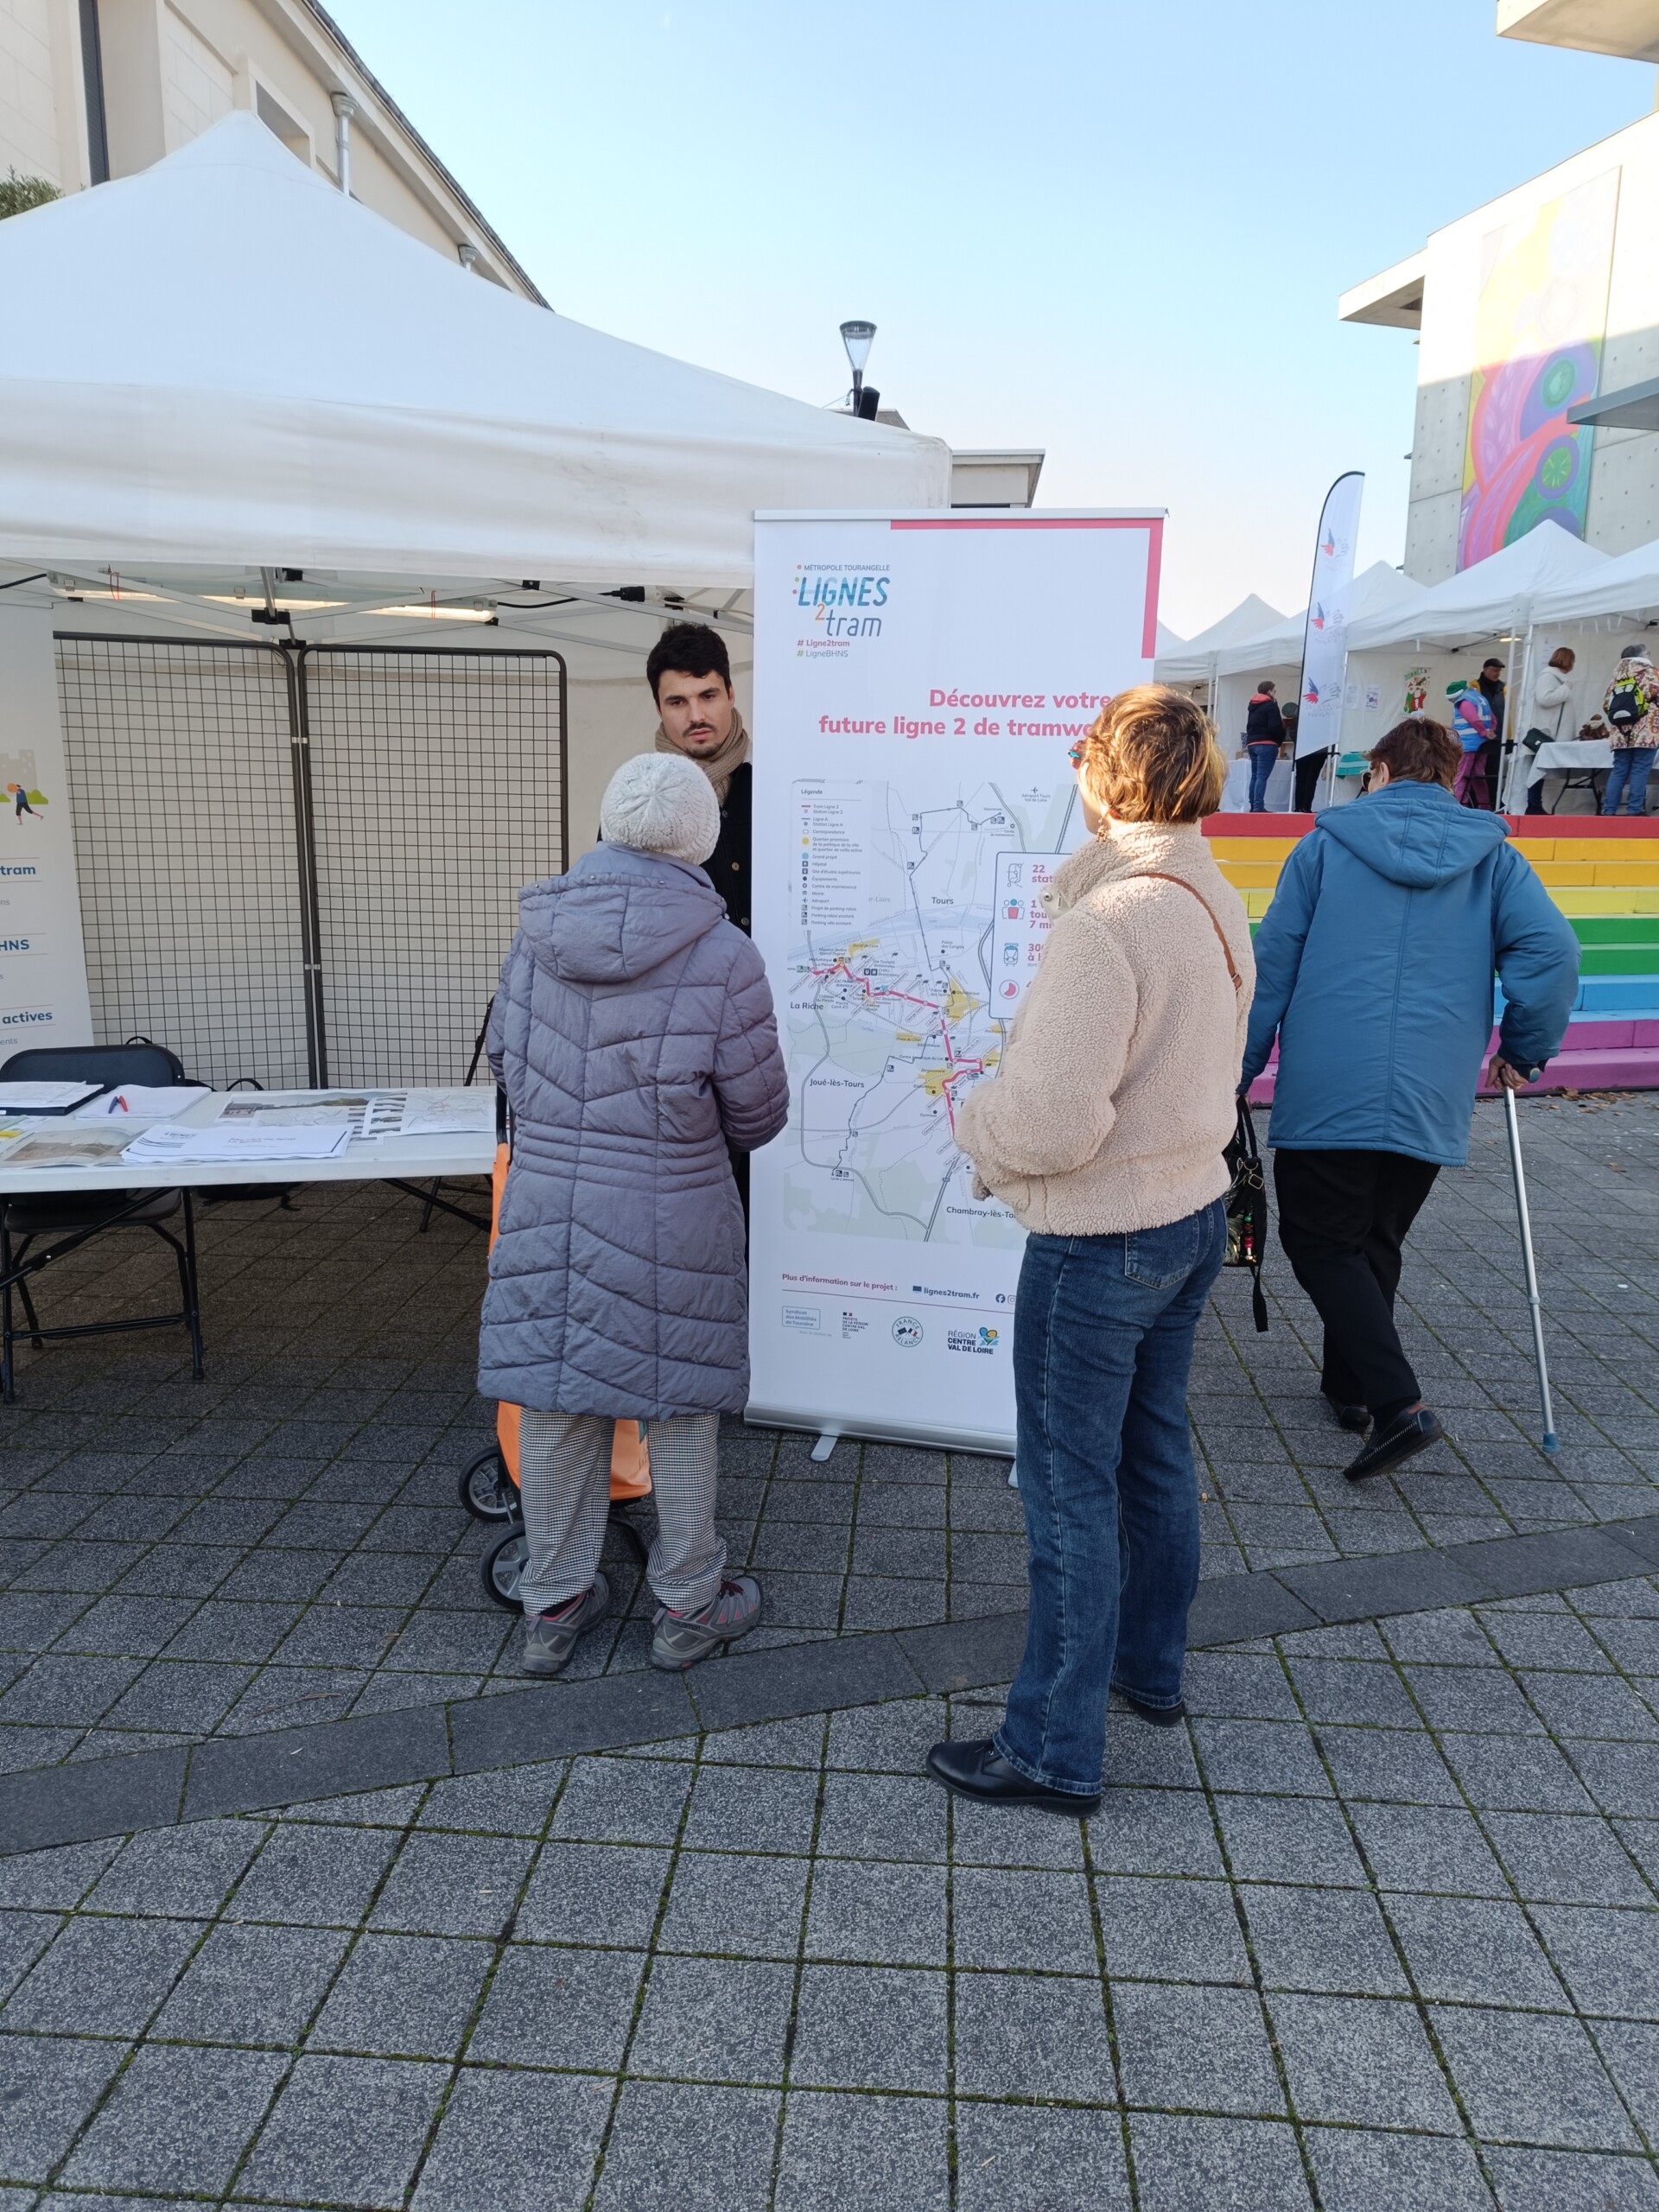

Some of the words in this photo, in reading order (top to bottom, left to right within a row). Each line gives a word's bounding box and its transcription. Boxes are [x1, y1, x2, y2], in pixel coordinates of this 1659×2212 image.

[798, 577, 890, 606] LIGNES
[815, 603, 825, 620] 2
[826, 609, 881, 637] tram
[806, 639, 850, 648] Ligne2tram
[806, 650, 849, 658] LigneBHNS
[930, 689, 1046, 709] Découvrez
[1052, 692, 1112, 709] votre
[819, 715, 886, 734] future
[893, 716, 946, 739] ligne
[954, 718, 966, 735] 2
[974, 717, 1000, 736] de
[1007, 719, 1093, 736] tramwa
[1033, 864, 1045, 873] 22
[931, 896, 954, 905] Tours
[1031, 899, 1037, 908] 1
[1030, 920, 1036, 929] 7
[0, 939, 29, 950] HNS
[3, 1011, 53, 1024] actives
[810, 1078, 865, 1088] Joué-lès-Tours
[946, 1206, 1016, 1218] Chambray-lès-To
[799, 1275, 849, 1287] d'information
[871, 1283, 893, 1292] projet
[924, 1287, 980, 1300] lignes2tram.fr
[895, 1319, 919, 1330] FRANCE
[894, 1333, 920, 1345] RELANCE
[947, 1330, 976, 1339] RÉGION
[947, 1338, 976, 1346] CENTRE
